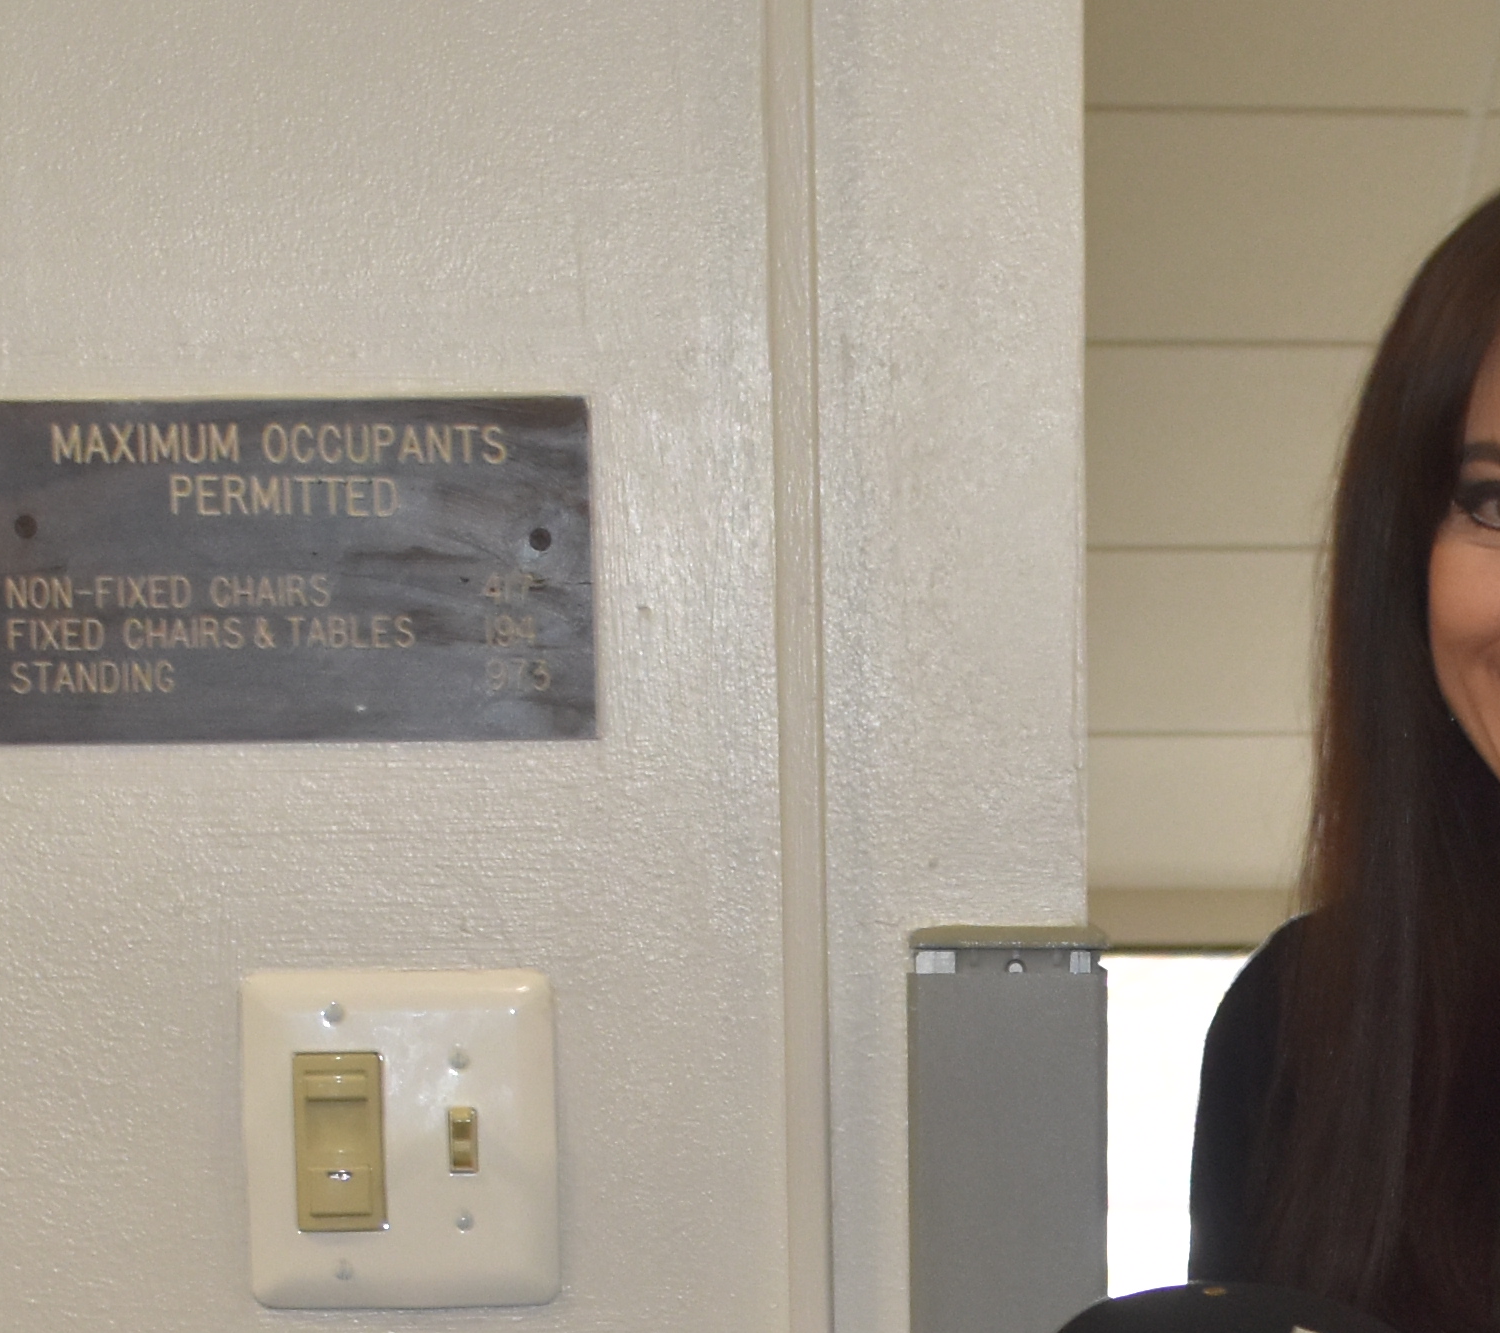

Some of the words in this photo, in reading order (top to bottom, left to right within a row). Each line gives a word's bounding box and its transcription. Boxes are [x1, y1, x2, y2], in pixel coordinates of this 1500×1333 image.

[51, 423, 240, 464] MAXIMUM
[262, 423, 509, 464] OCCUPANTS
[170, 475, 399, 517] PERMITTED
[4, 576, 190, 609] NON-FIXED
[210, 573, 332, 608] CHAIRS
[6, 617, 105, 651] FIXED
[122, 617, 243, 650] CHAIRS
[253, 618, 276, 648] &
[286, 616, 415, 648] TABLES
[10, 661, 175, 694] STANDING
